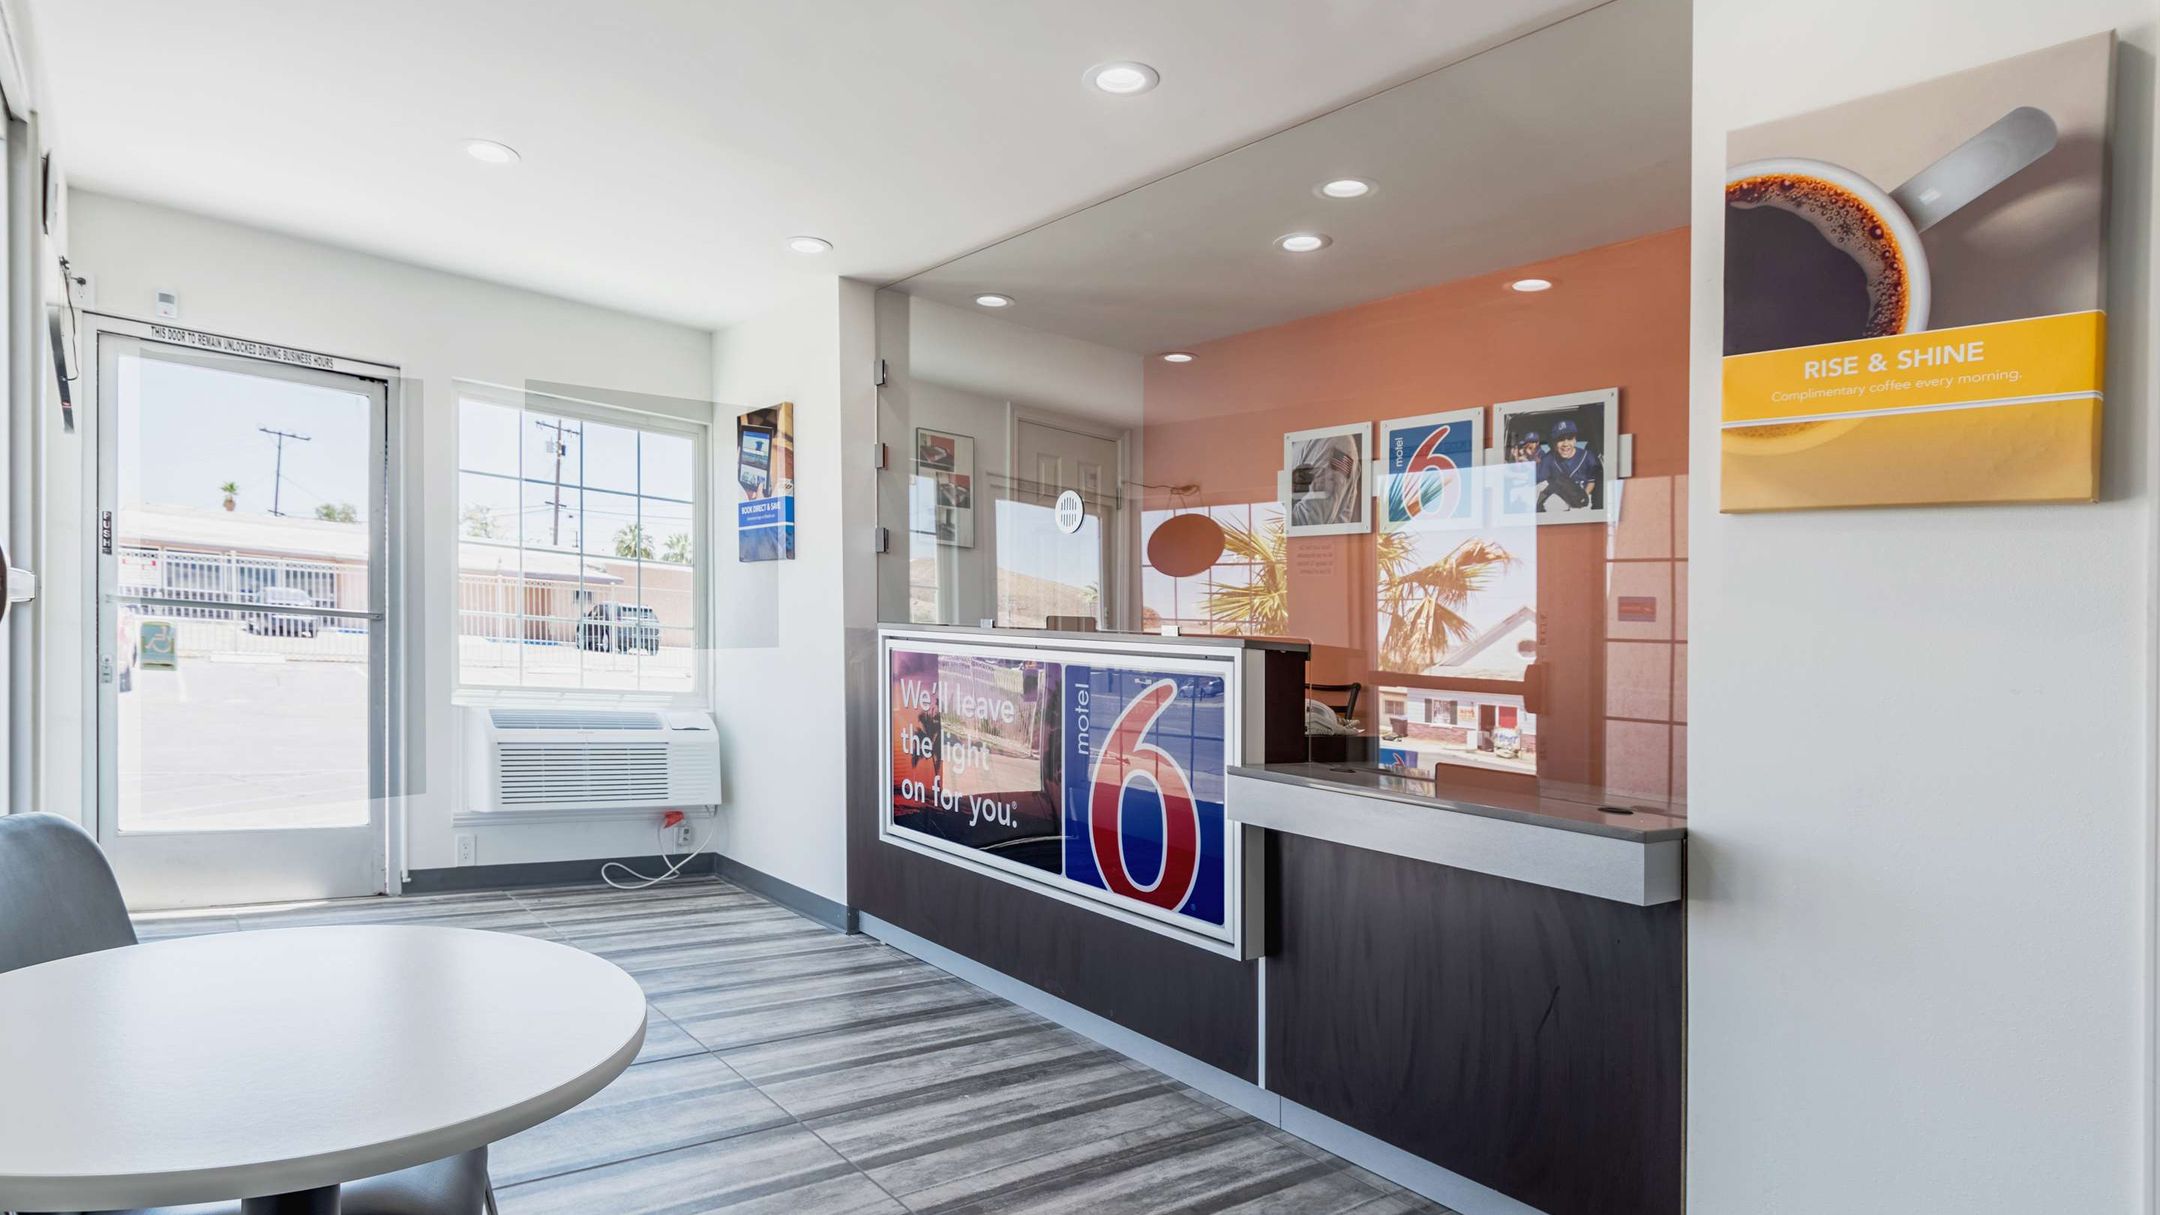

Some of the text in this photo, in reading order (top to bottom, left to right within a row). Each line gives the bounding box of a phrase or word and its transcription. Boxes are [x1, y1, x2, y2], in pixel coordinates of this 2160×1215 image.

[151, 326, 334, 369] THIS DOOR TO REMAIN UNLOCKED DURING BUSINESS HOURS
[1804, 341, 1984, 379] RISE & SHINE
[1771, 369, 2022, 402] Complimentary coffee every morning.
[1395, 425, 1461, 520] motel 6
[103, 511, 111, 547] PUSH
[901, 679, 1015, 723] We'll leave
[901, 724, 990, 774] the light
[902, 779, 925, 803] on
[932, 776, 963, 812] for
[1075, 678, 1201, 912] motel 6
